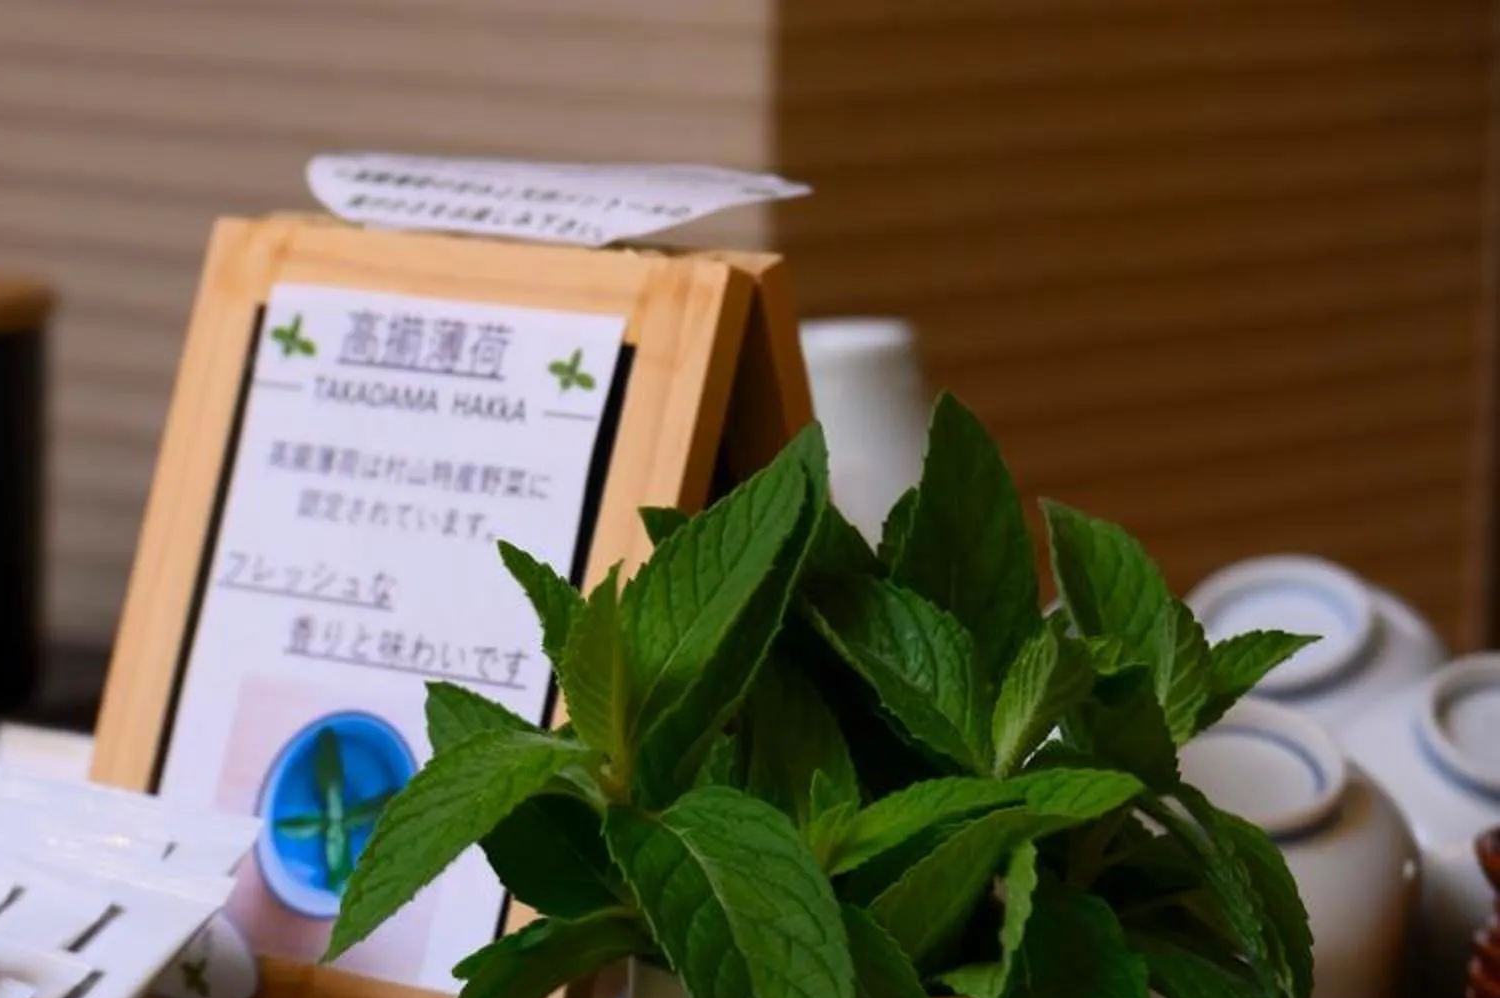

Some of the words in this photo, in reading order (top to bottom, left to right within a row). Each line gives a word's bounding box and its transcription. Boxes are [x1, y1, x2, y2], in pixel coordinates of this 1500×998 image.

[313, 375, 438, 413] TAKADAMA
[222, 550, 399, 606] フレッシュな
[287, 615, 531, 684] 香りと味わいです
